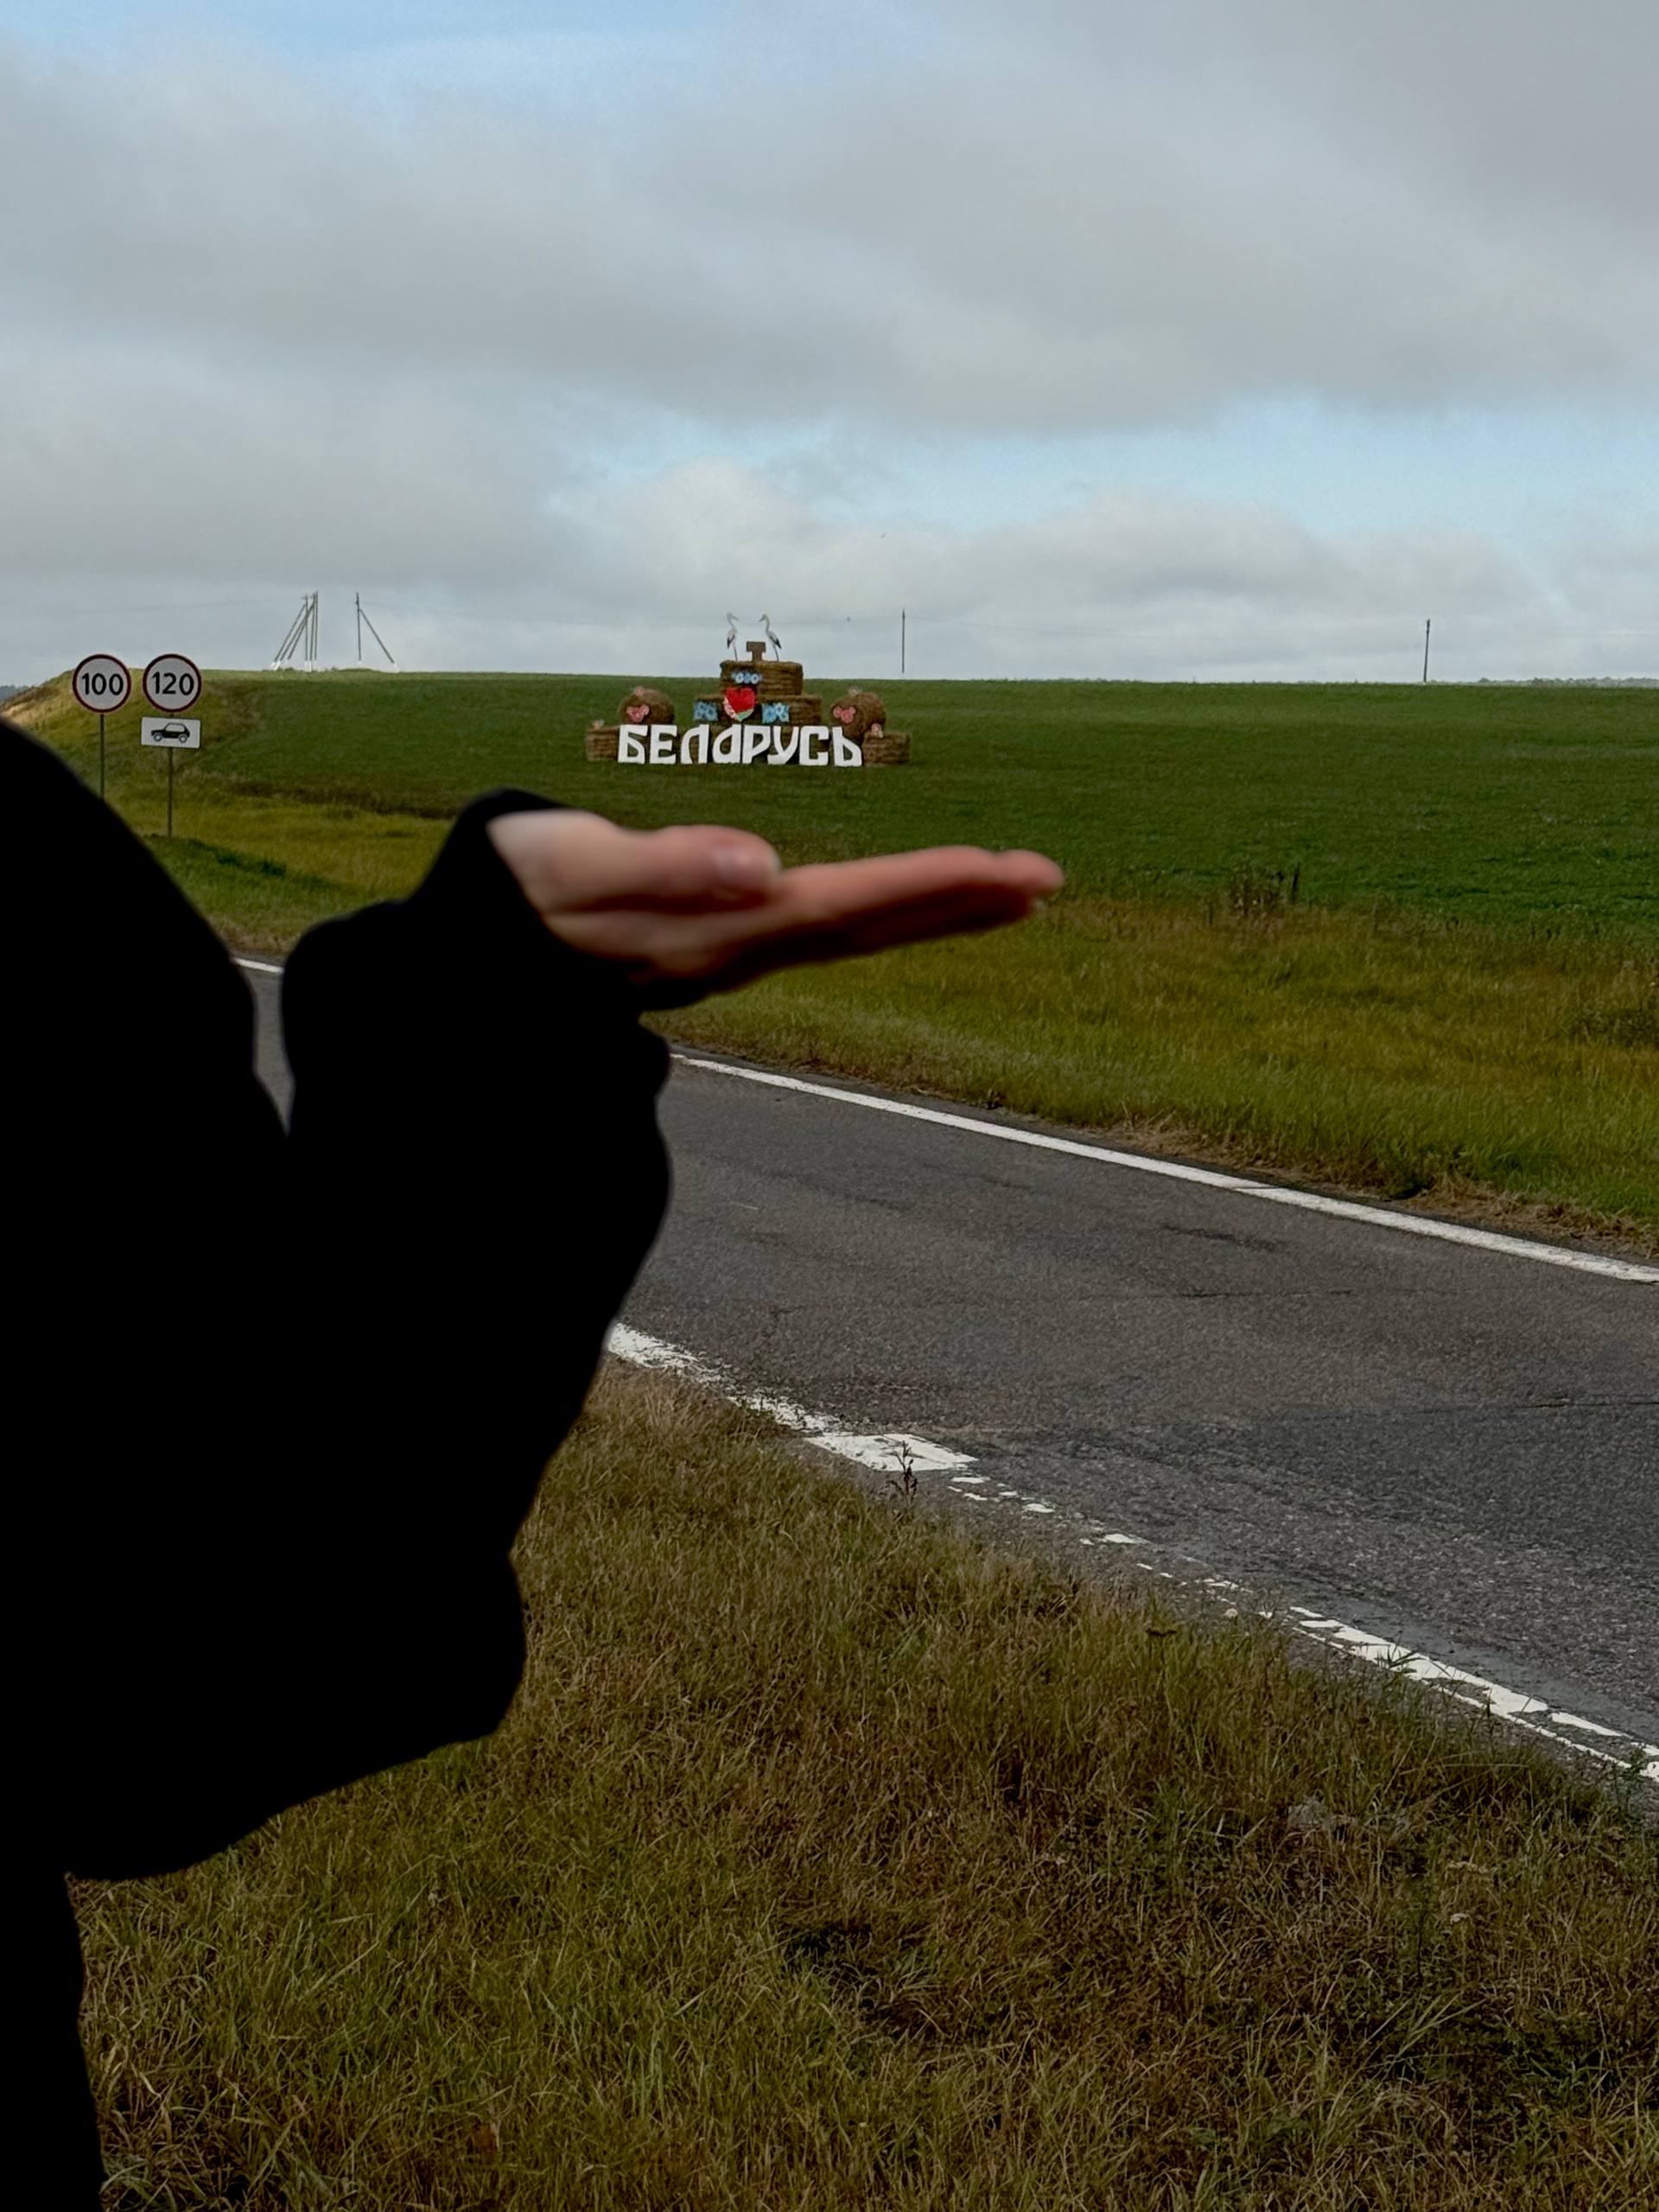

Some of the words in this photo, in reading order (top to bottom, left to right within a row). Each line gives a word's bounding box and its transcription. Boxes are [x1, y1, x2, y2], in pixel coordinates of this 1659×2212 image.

[81, 672, 124, 696] 100
[152, 671, 194, 696] 120
[617, 723, 862, 767] БЕЛАРУСЬ
